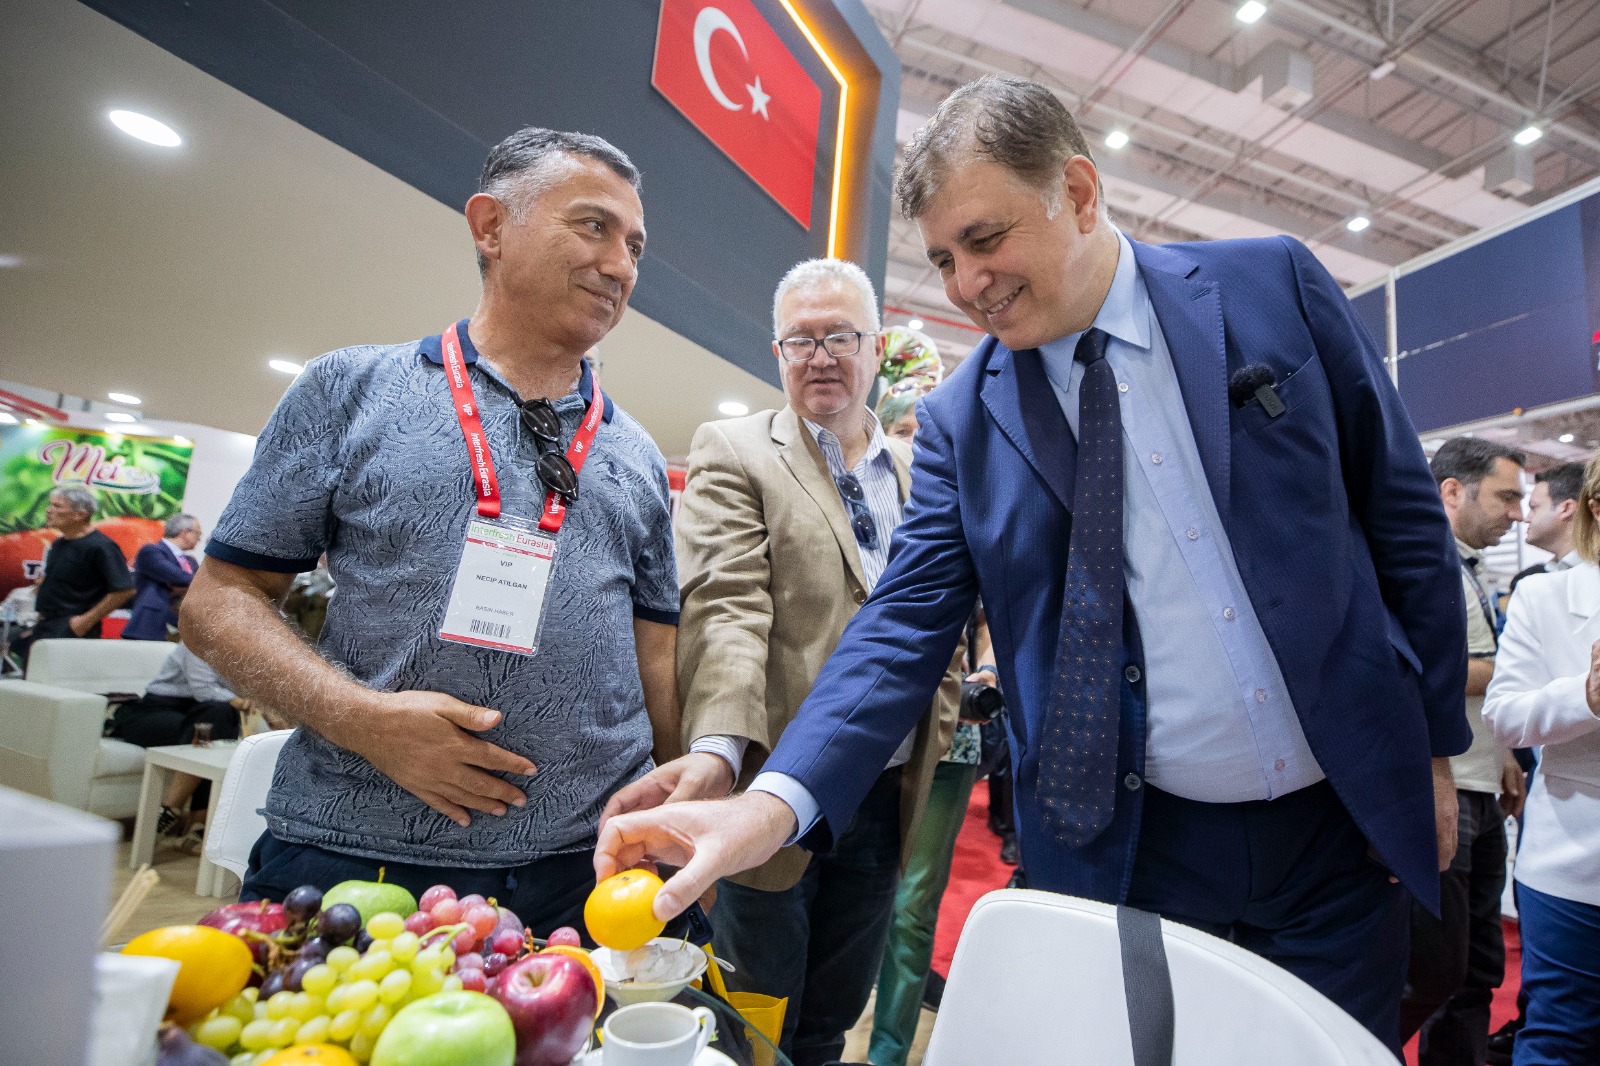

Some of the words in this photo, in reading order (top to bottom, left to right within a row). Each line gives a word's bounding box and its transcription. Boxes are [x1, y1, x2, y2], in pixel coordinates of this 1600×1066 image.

[462, 402, 473, 417] VIP
[574, 440, 584, 453] VIP
[471, 432, 486, 467] Interfresh
[479, 467, 493, 497] Eurasia
[470, 523, 515, 542] Interfresh
[516, 533, 549, 550] Eurasia
[500, 560, 513, 568] VIP
[498, 579, 527, 590] ATILGAN
